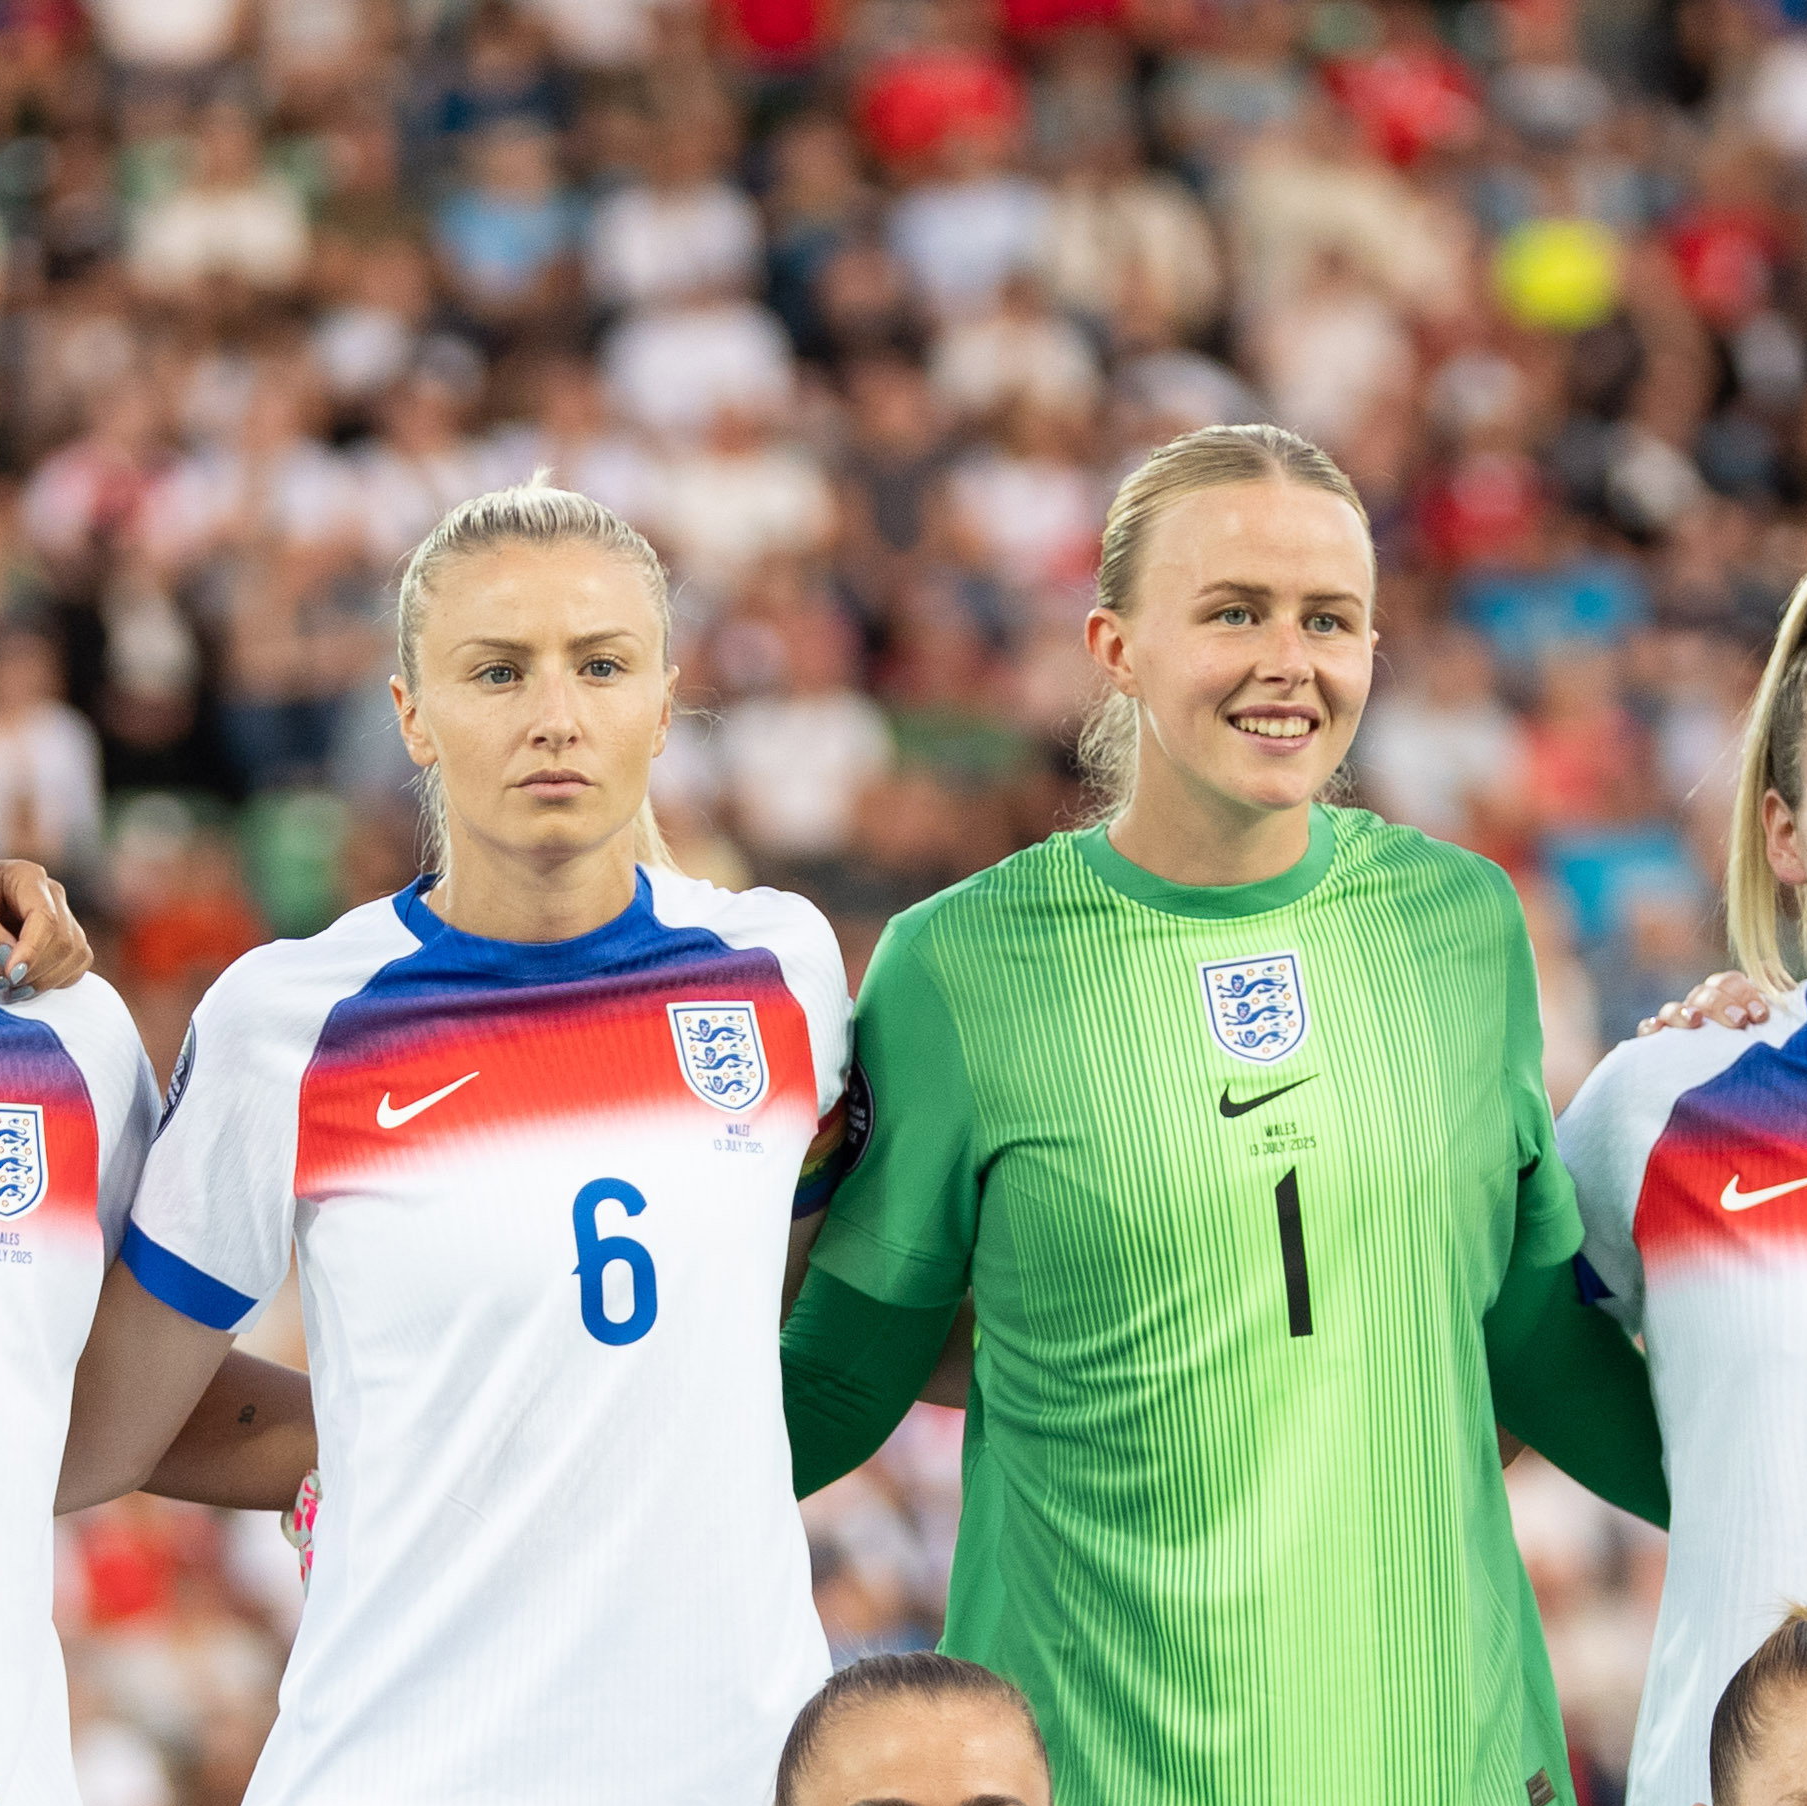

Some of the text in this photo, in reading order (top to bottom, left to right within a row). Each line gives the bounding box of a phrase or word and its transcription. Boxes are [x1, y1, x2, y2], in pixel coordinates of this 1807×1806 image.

[1264, 1121, 1297, 1137] WALES
[1262, 1141, 1285, 1155] JULY
[1290, 1135, 1317, 1151] 2025
[10, 1249, 33, 1265] 2025
[571, 1177, 658, 1346] 6
[1275, 1166, 1313, 1338] 1
